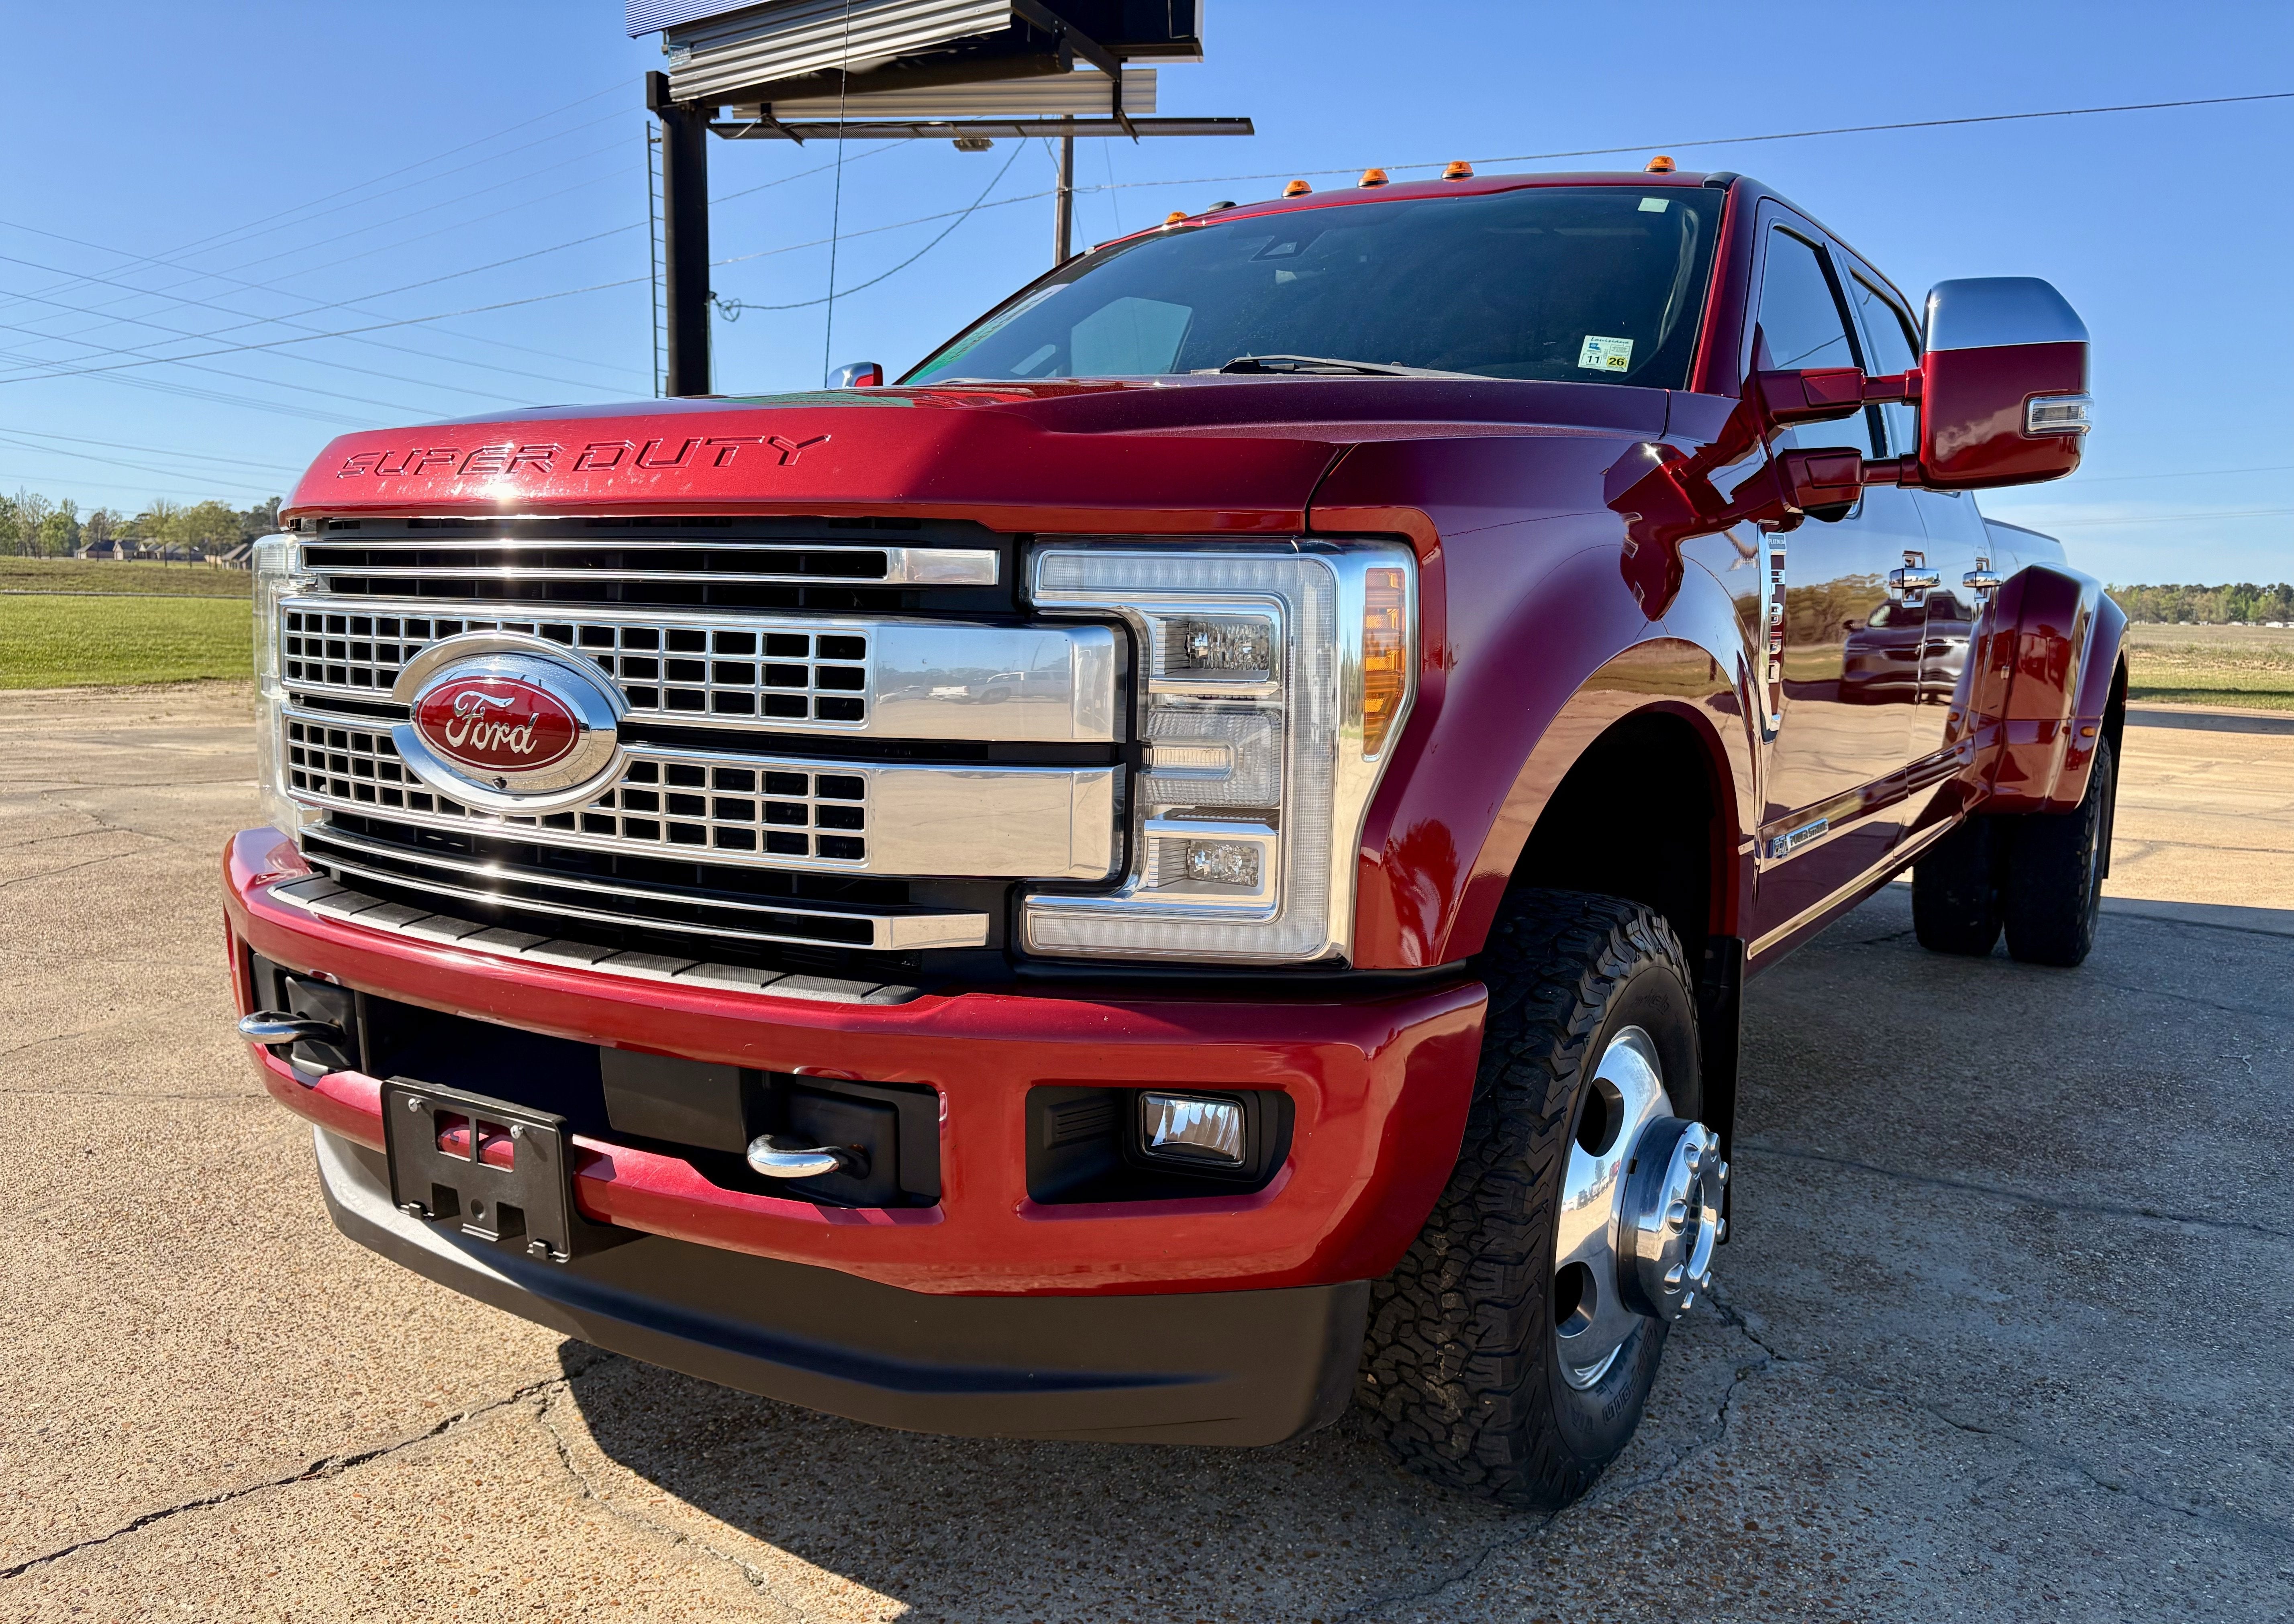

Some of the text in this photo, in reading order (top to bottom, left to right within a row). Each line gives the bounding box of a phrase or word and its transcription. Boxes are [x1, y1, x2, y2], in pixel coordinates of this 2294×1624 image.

[1587, 355, 1600, 363] 11
[1608, 357, 1624, 366] 26
[337, 435, 831, 479] SUPER DUTY
[445, 691, 537, 755] Ford
